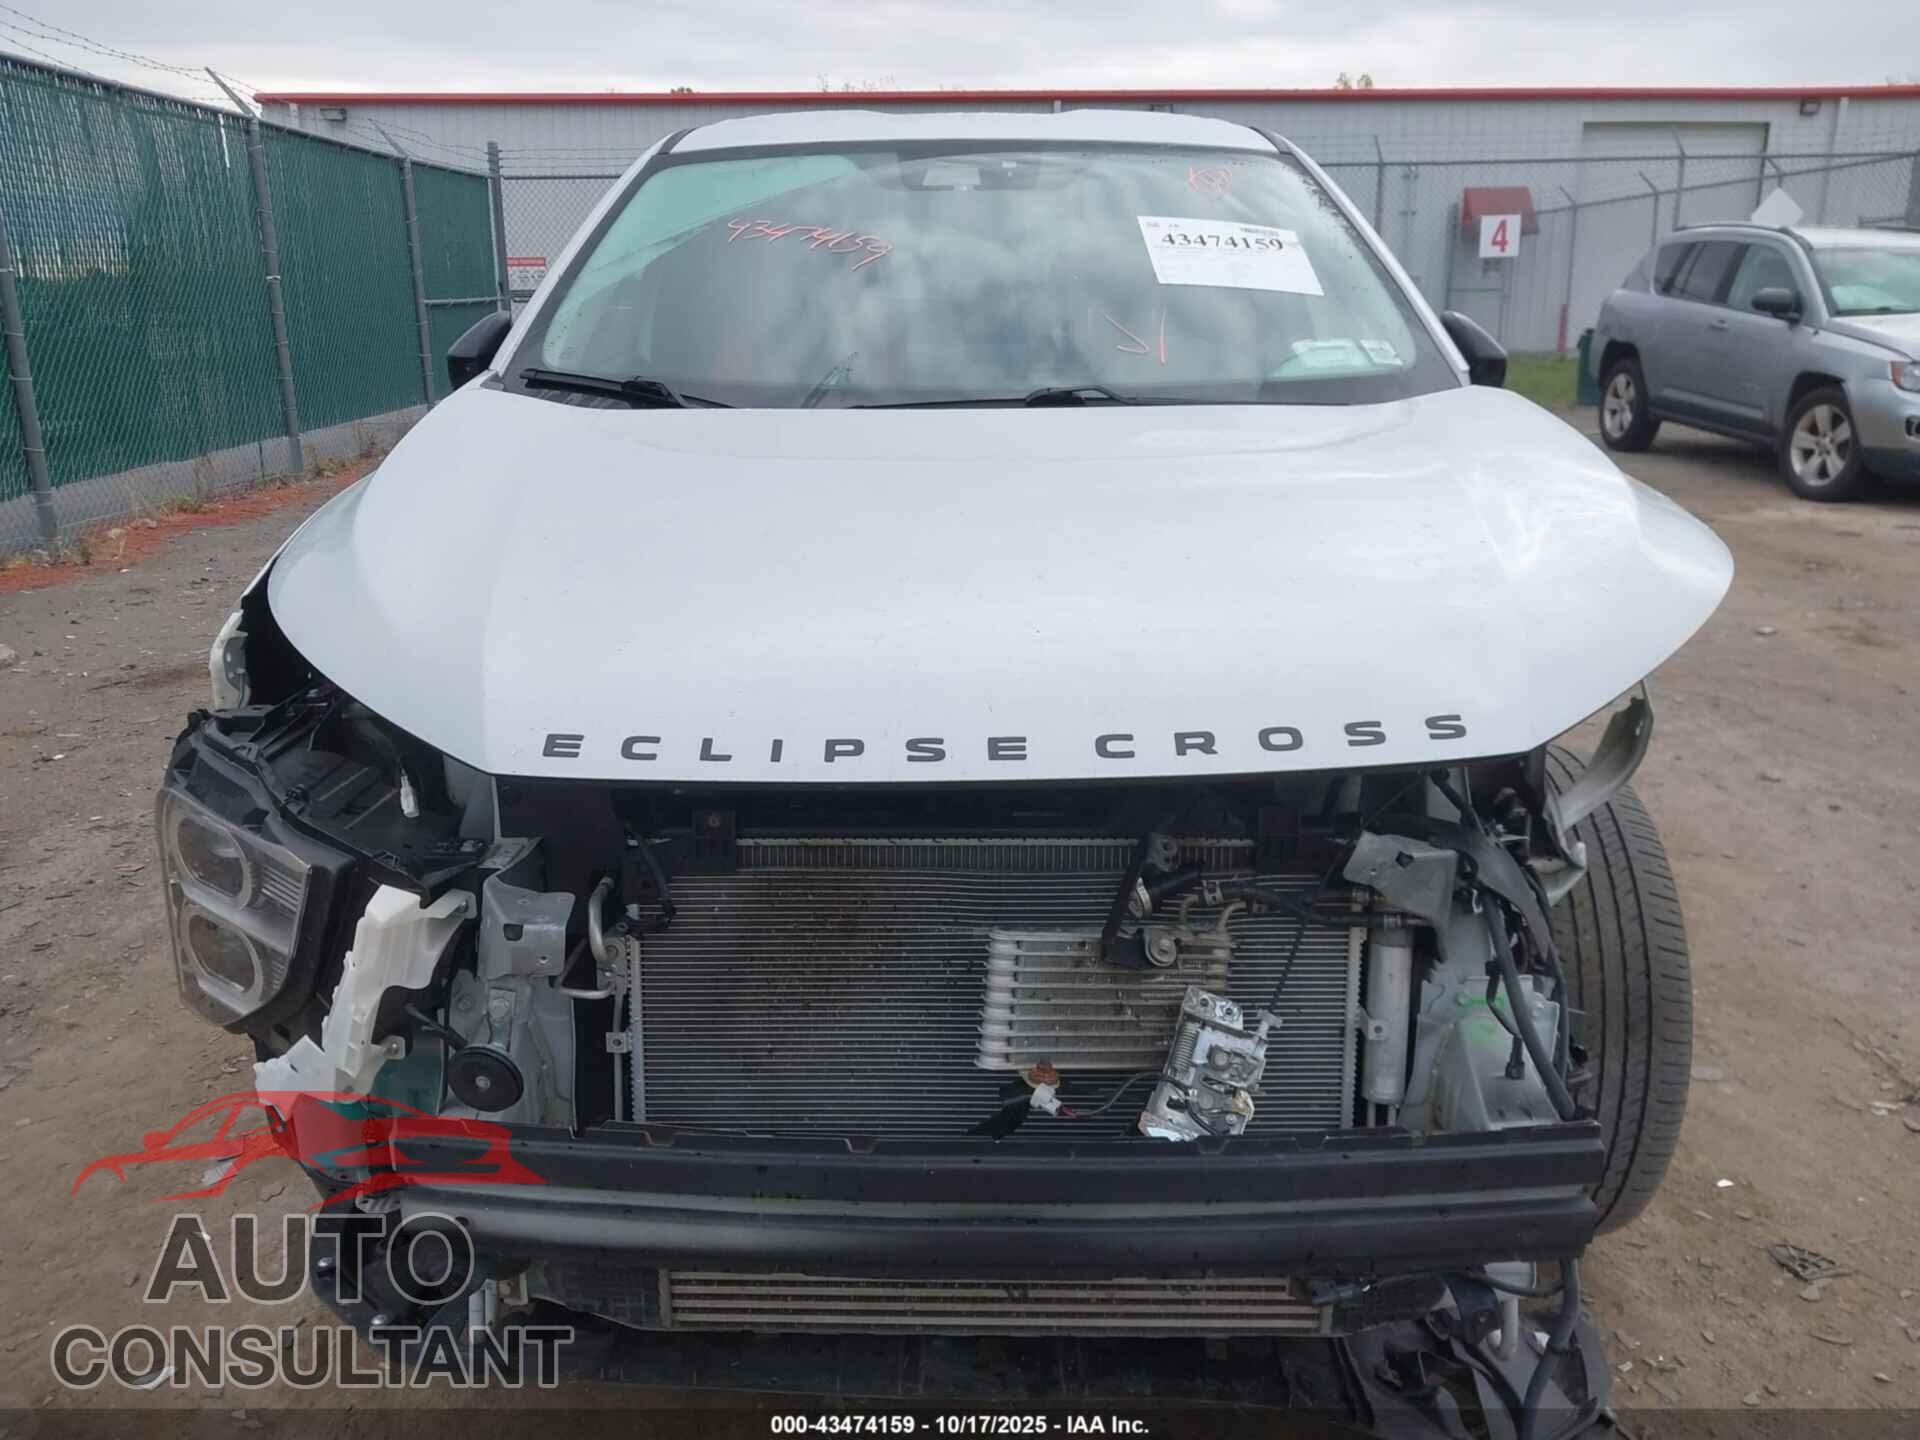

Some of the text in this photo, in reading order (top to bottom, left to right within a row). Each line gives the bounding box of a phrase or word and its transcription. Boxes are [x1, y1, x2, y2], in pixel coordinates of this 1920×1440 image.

[1161, 232, 1285, 252] 43474159
[1491, 219, 1509, 253] 4
[541, 714, 1468, 763] ECLIPSE CROSS
